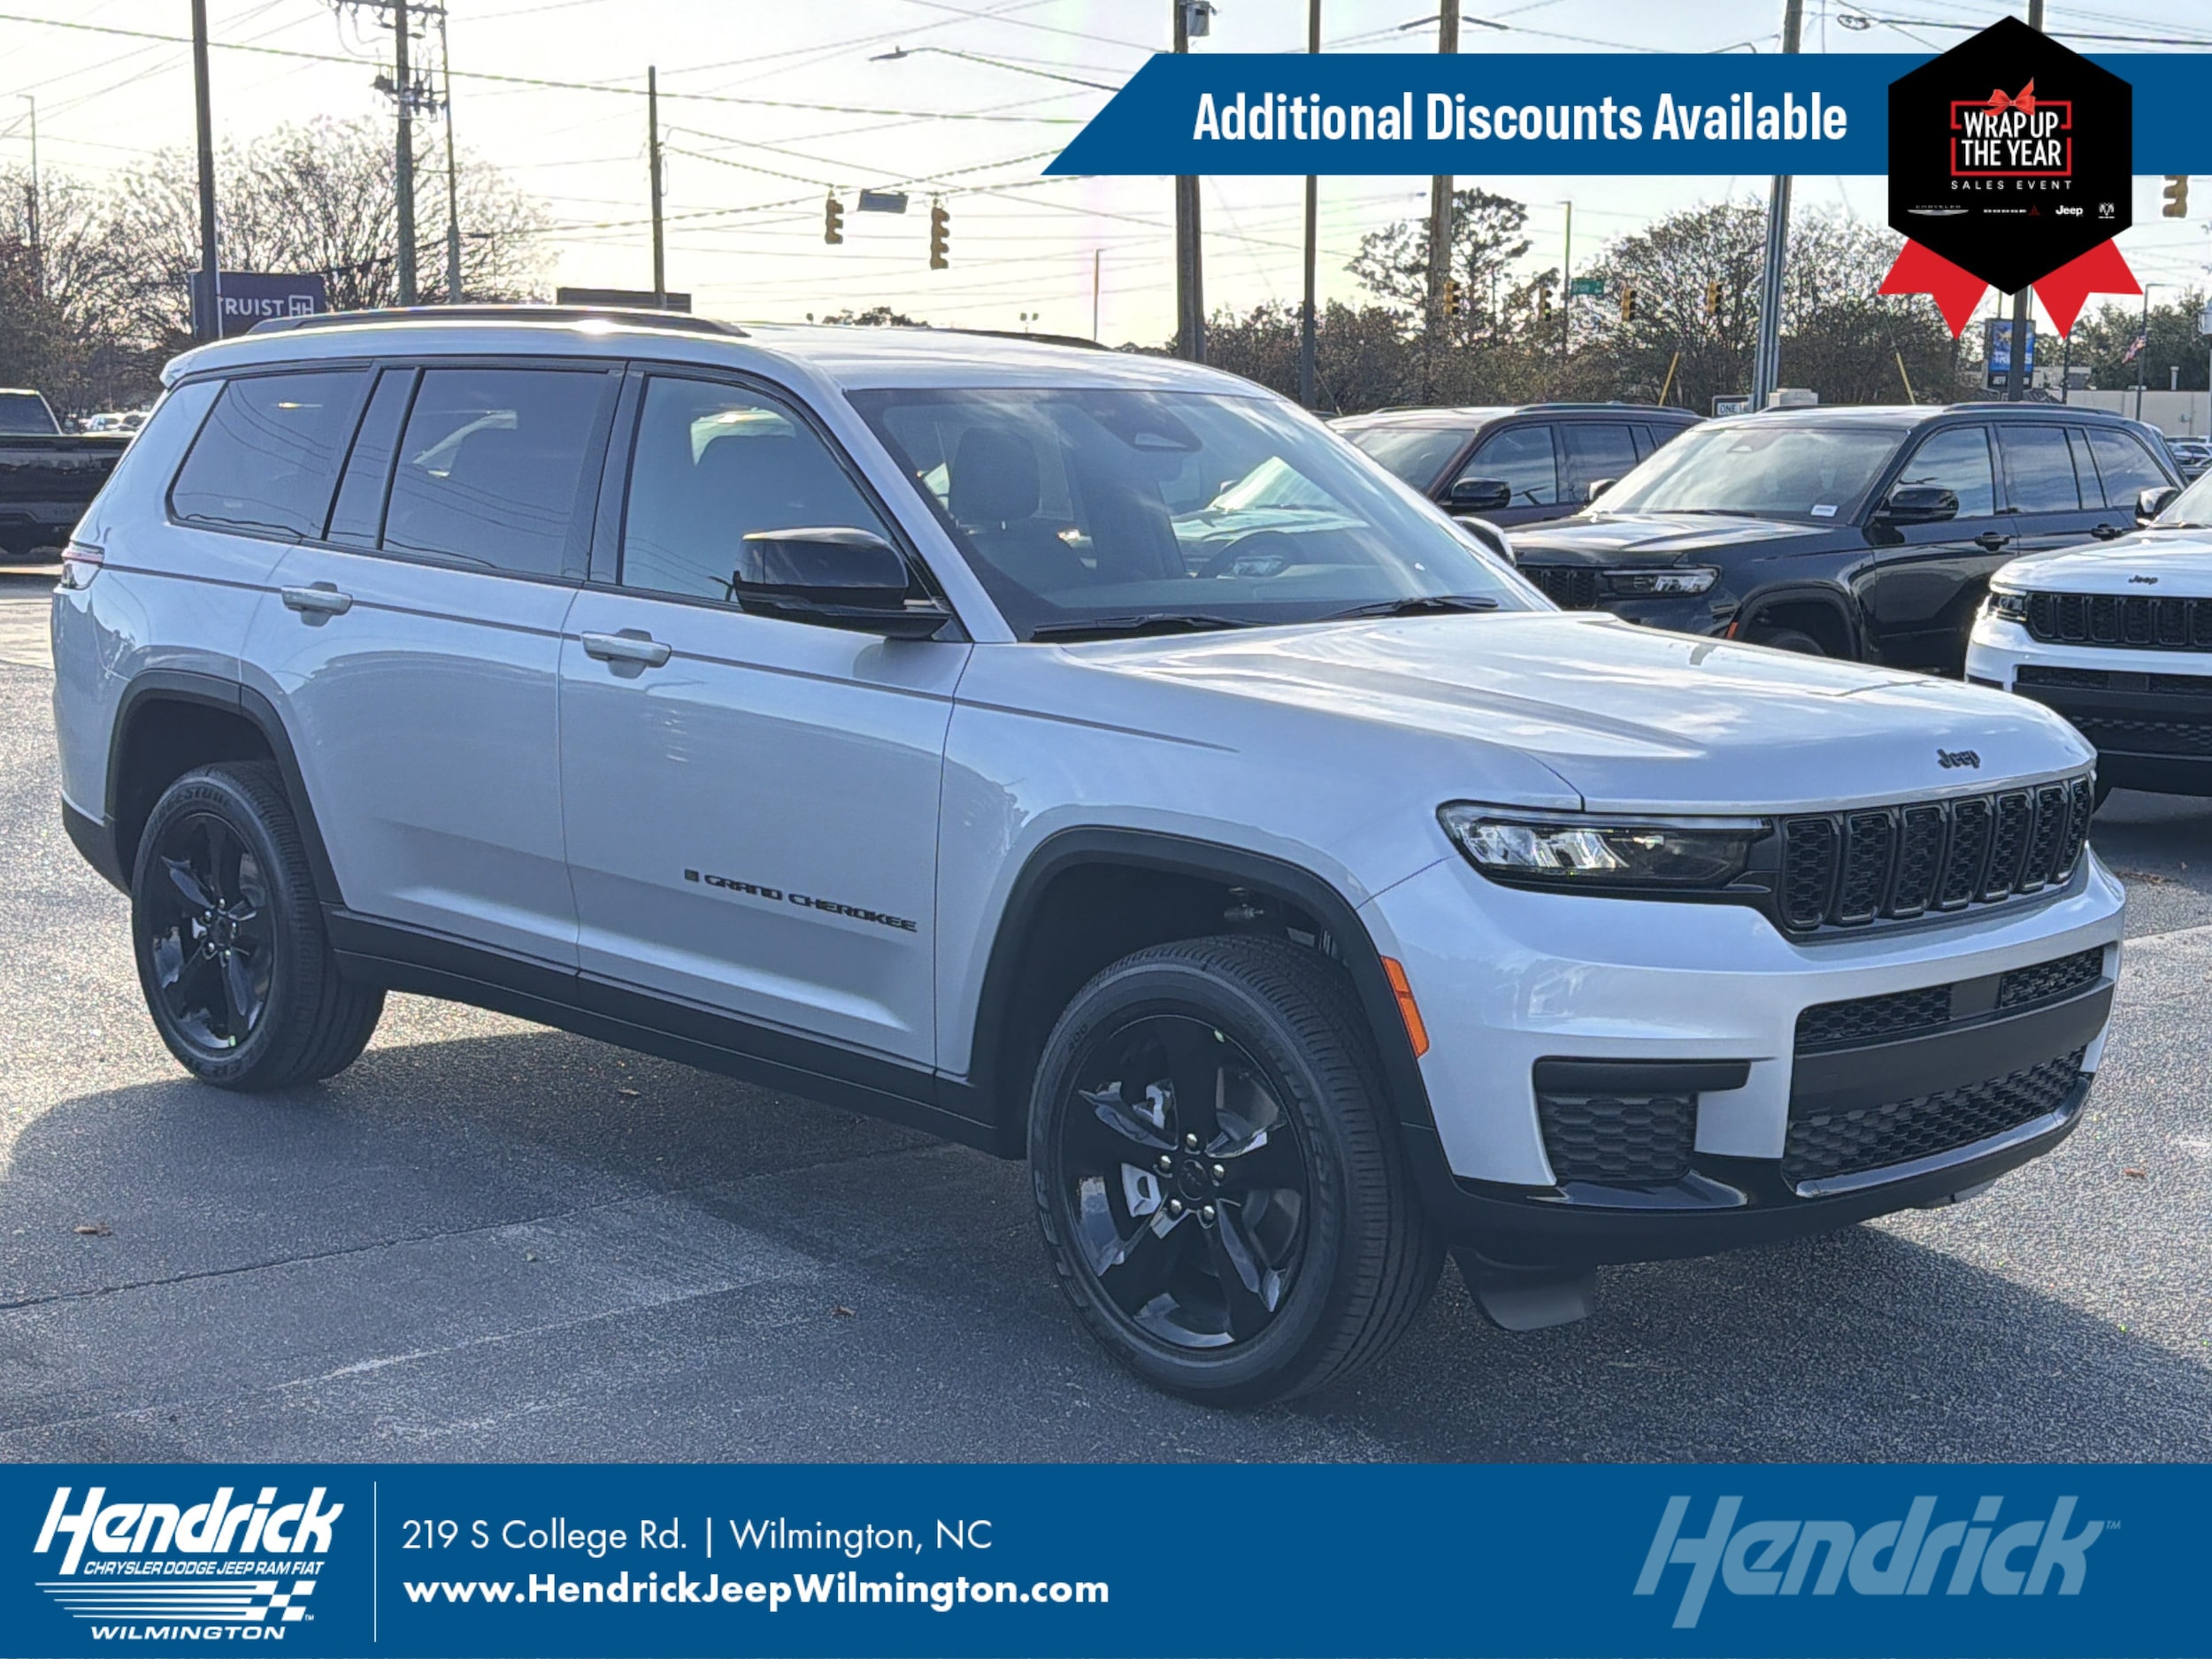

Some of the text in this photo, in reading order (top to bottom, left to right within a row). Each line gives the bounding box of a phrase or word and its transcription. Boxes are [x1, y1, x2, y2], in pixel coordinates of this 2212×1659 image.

[2127, 574, 2159, 586] Jeep
[1937, 749, 1981, 769] Jeep
[704, 873, 918, 933] GRAND CHEROKEE
